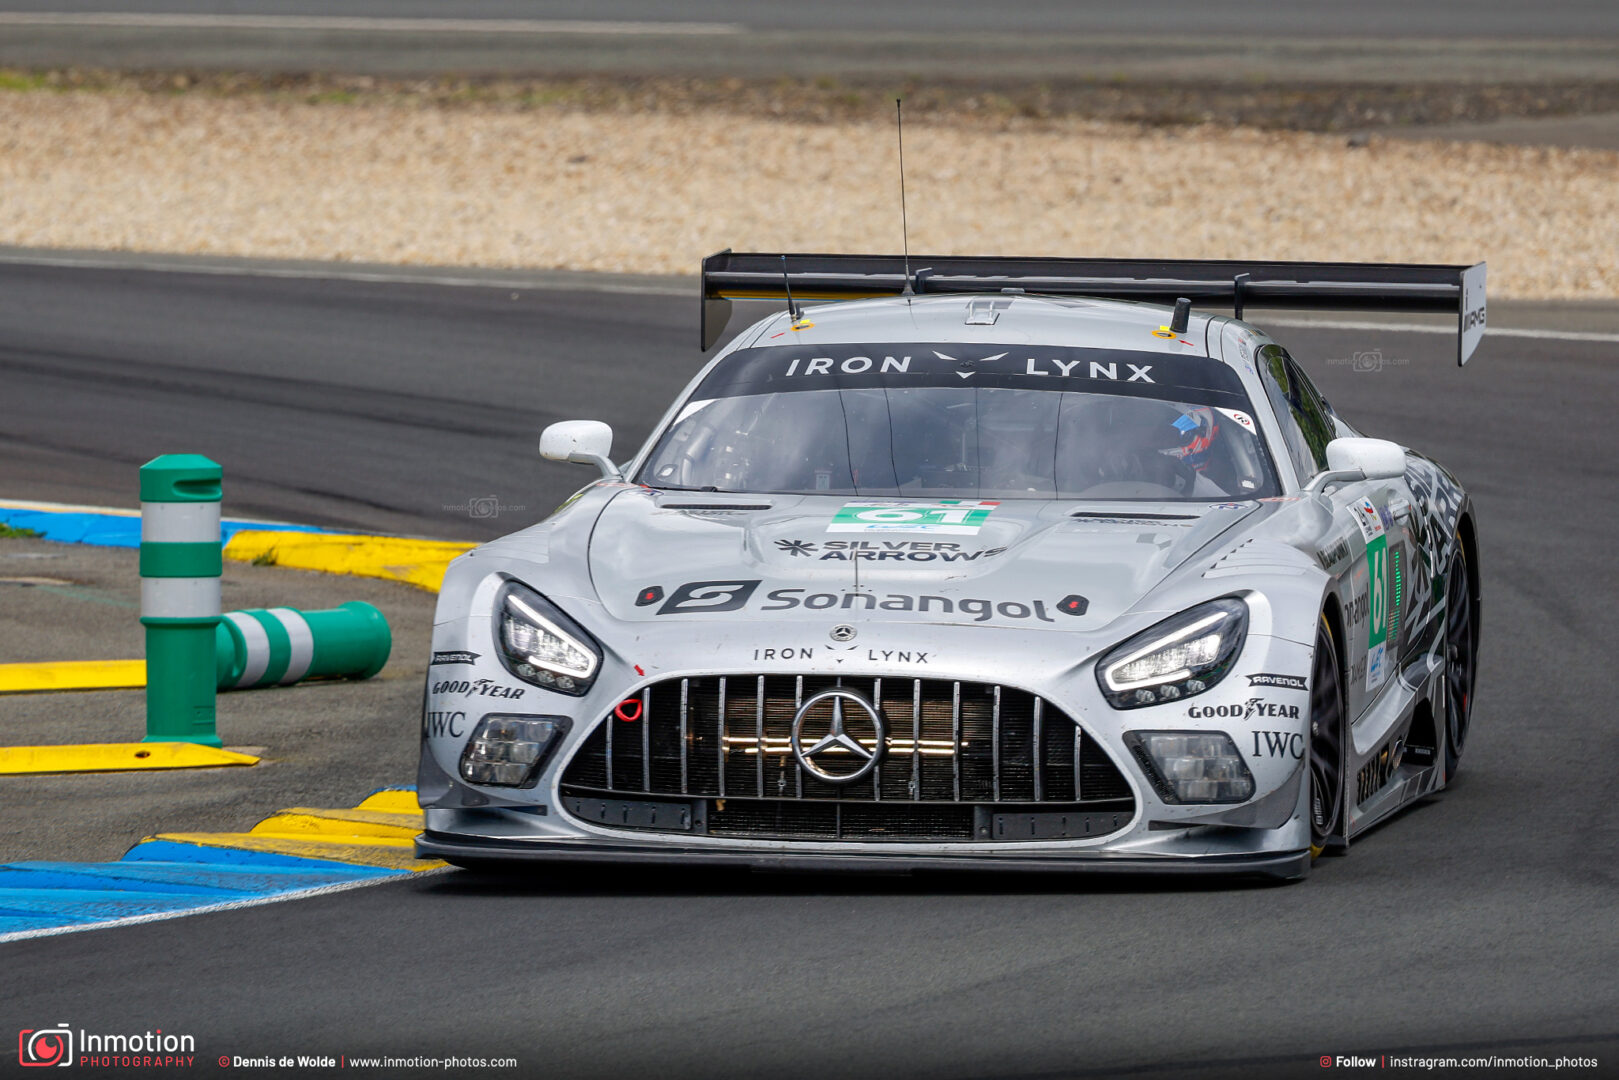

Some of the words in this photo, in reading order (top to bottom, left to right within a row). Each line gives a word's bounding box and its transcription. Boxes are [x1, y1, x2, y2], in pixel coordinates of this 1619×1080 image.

[785, 356, 912, 377] IRON
[1026, 358, 1156, 384] LYNX
[855, 507, 972, 525] 61
[817, 540, 961, 551] SILVER
[819, 547, 1008, 562] ARROWS
[1373, 547, 1388, 635] 61
[761, 588, 1055, 622] Sonangol
[754, 647, 813, 661] IRON
[868, 649, 929, 664] LYNX
[432, 679, 525, 699] GOODYEAR
[1188, 698, 1300, 720] GOODYEAR
[1251, 730, 1306, 760] IWC
